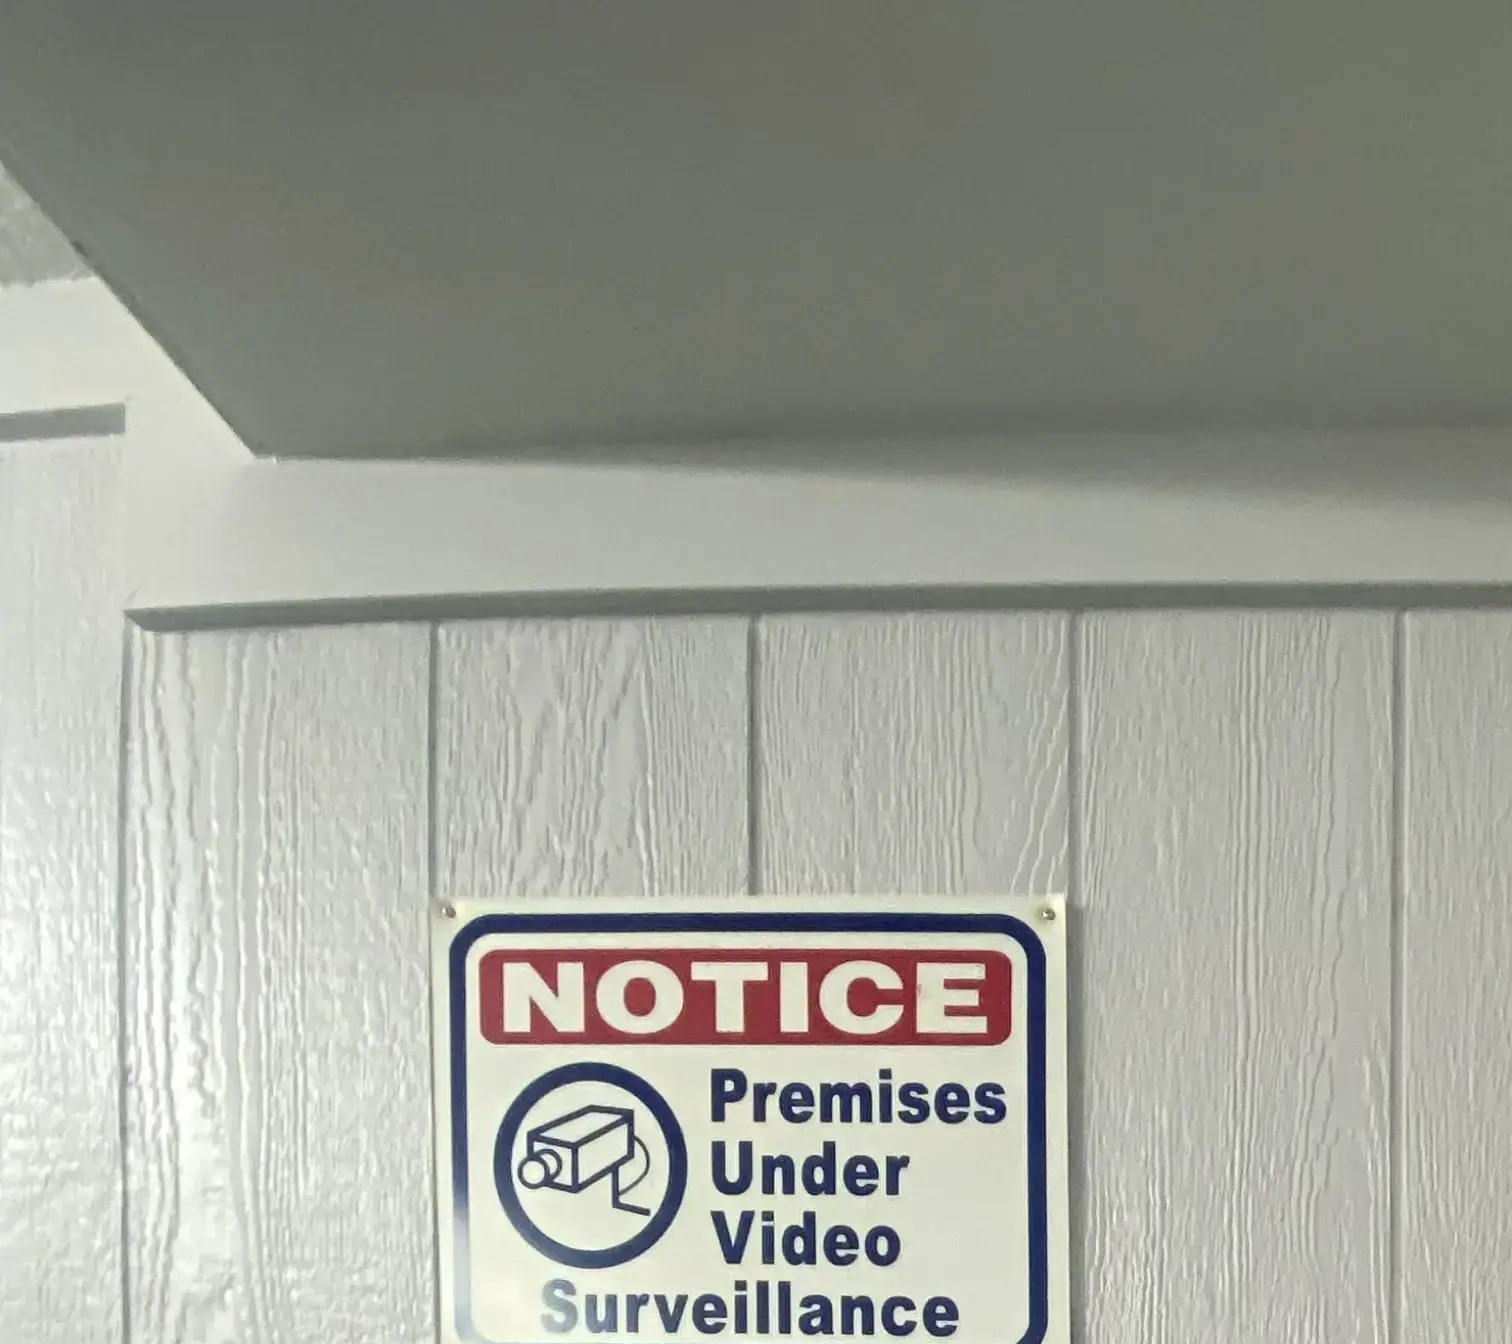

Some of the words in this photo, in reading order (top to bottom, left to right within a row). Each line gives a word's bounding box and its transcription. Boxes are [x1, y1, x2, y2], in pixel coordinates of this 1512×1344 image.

[502, 959, 989, 1035] NOTICE
[710, 1068, 1007, 1125] Premises
[711, 1140, 910, 1196] Under
[710, 1210, 901, 1267] Video
[540, 1278, 959, 1336] Surveillance
